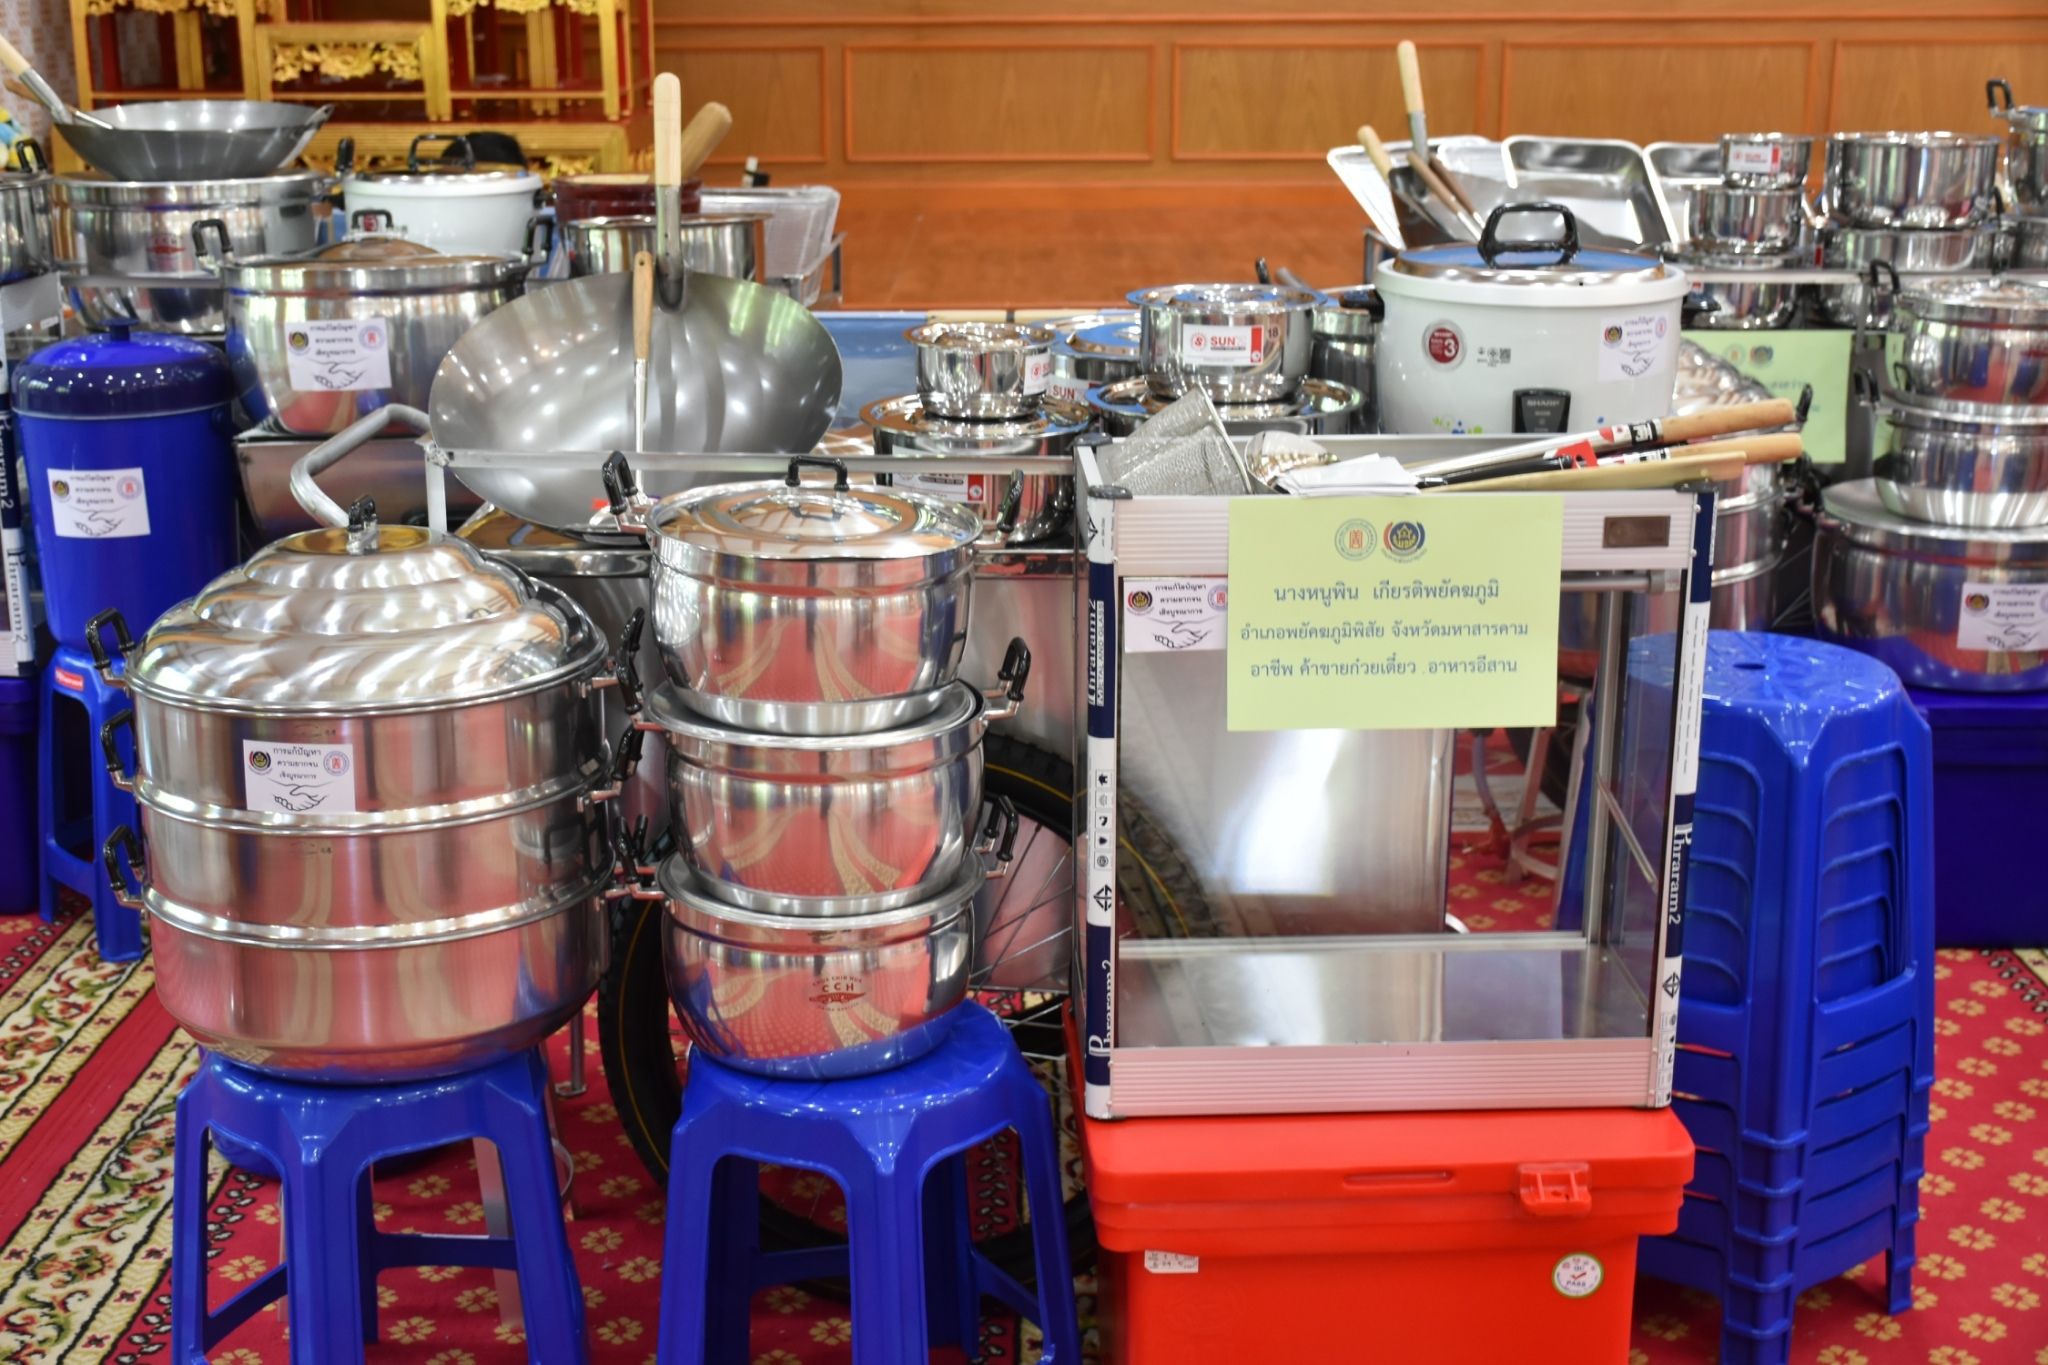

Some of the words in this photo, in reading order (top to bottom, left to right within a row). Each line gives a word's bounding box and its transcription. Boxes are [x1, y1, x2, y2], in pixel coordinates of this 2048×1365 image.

[1211, 335, 1236, 347] SUN
[1444, 338, 1457, 358] 3
[1052, 384, 1075, 400] SUN
